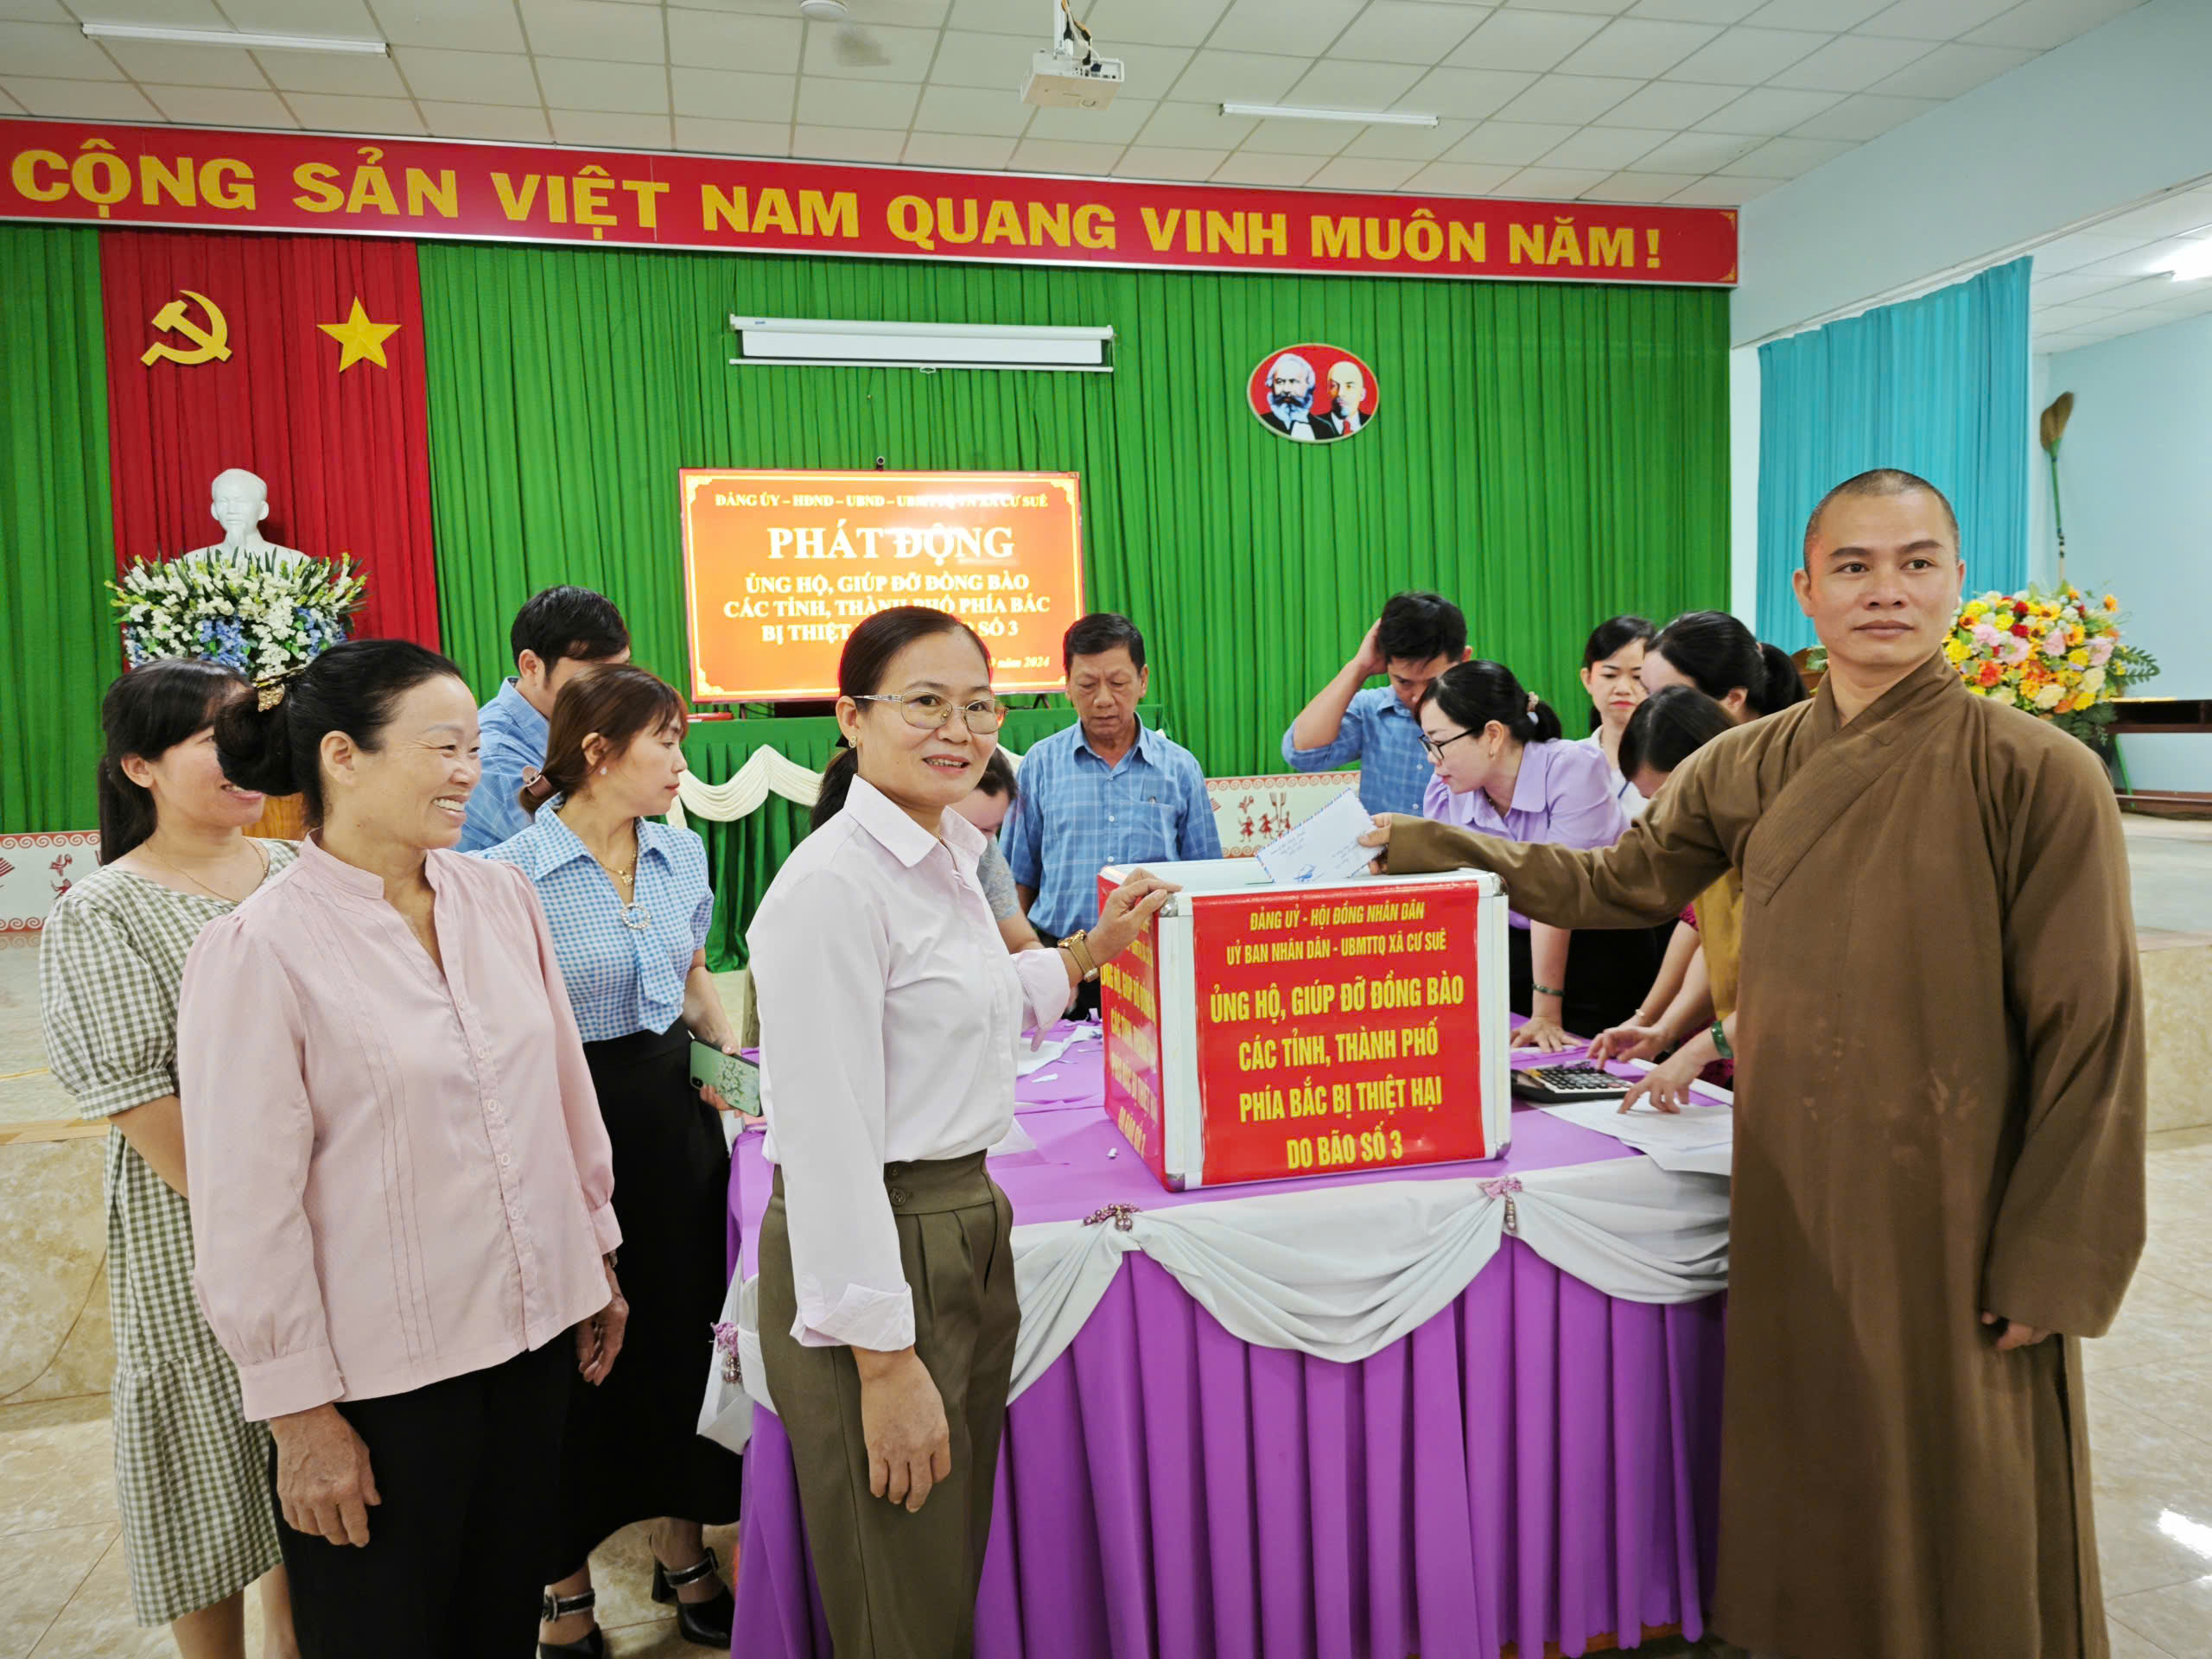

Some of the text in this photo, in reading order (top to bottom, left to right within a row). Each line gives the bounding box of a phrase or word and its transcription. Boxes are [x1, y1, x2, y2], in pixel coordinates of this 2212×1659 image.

[10, 137, 256, 218] CỘNG
[292, 147, 459, 218] SẢN
[490, 165, 670, 240] VIỆT
[701, 184, 859, 238] NAM
[887, 194, 1116, 251] QUANG
[1140, 207, 1287, 256] VINH
[1311, 208, 1485, 263] MUÔN
[792, 494, 835, 507] HĐND
[846, 494, 886, 507] UBND
[1022, 493, 1049, 508] SUÊ
[767, 518, 1015, 567] PHÁT ĐỘNG
[796, 574, 835, 597] HỘ,
[837, 571, 888, 594] GIÚP
[891, 571, 923, 593] ĐỠ
[987, 569, 1030, 591] BÀO
[723, 596, 770, 618] CÁC
[959, 592, 1007, 614] PHÍA
[761, 624, 784, 645] BỊ
[787, 622, 852, 644] THIỆT
[1007, 620, 1019, 637] 3
[1249, 906, 1282, 931] ĐẢNG
[1310, 904, 1331, 931] HỘI
[1366, 900, 1399, 923] NHÂN
[1401, 898, 1425, 920] DÂN
[1244, 944, 1268, 964] BAN
[1271, 938, 1304, 962] NHÂN
[1306, 935, 1331, 960] DÂN
[1340, 935, 1386, 957] UBMTTQ
[1389, 930, 1404, 954] XÃ
[1407, 931, 1424, 952] CƯ
[1425, 927, 1446, 951] SUÊ
[1210, 983, 1249, 1024] ỦNG
[1255, 982, 1286, 1025] HỘ,
[1291, 979, 1335, 1016] GIÚP
[1339, 975, 1366, 1012] ĐỠ
[1427, 969, 1464, 1006] BÀO
[1238, 1015, 1439, 1071] CÁC TỈNH, THÀNH PHỐ
[1239, 1074, 1443, 1122] PHÍA BẮC BỊ THIỆT HẠI
[1287, 1121, 1403, 1169] DO BÃO SỐ 3
